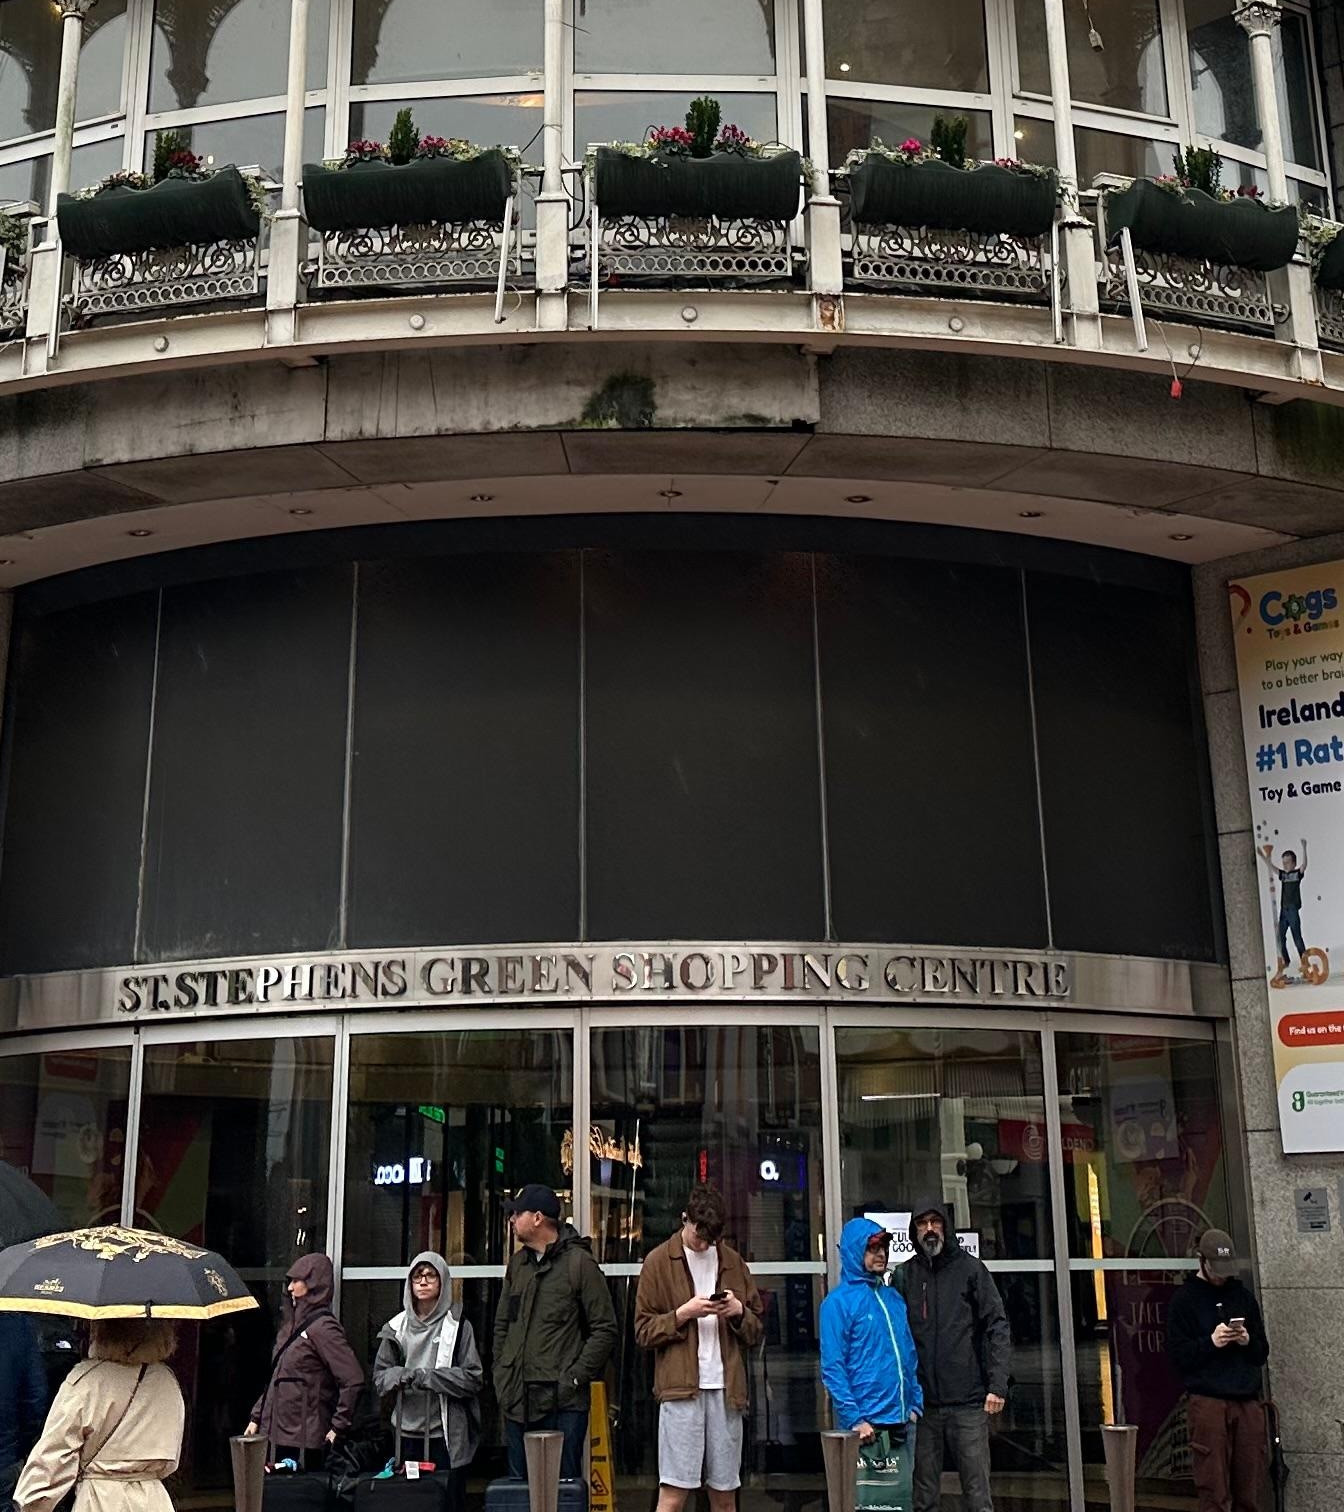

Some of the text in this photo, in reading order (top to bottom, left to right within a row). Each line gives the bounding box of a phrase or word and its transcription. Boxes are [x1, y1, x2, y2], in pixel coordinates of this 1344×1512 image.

[1259, 588, 1337, 625] Cogs
[1294, 624, 1302, 634] &
[1265, 652, 1343, 672] Play your way
[1262, 680, 1273, 690] to
[1276, 679, 1283, 687] a
[1286, 673, 1319, 687] better
[1256, 742, 1288, 772] #1
[1259, 787, 1283, 803] Toy
[1287, 783, 1298, 798] &
[1301, 780, 1342, 795] Game
[419, 952, 594, 995] GREEN
[612, 951, 870, 991] SHOPPING
[883, 955, 1071, 997] CENTRE
[1289, 1026, 1306, 1035] Find
[1307, 1027, 1315, 1035] us
[1317, 1026, 1327, 1034] on
[1329, 1024, 1342, 1033] the
[1130, 1301, 1165, 1324] TAKE
[1138, 1330, 1165, 1352] FOR
